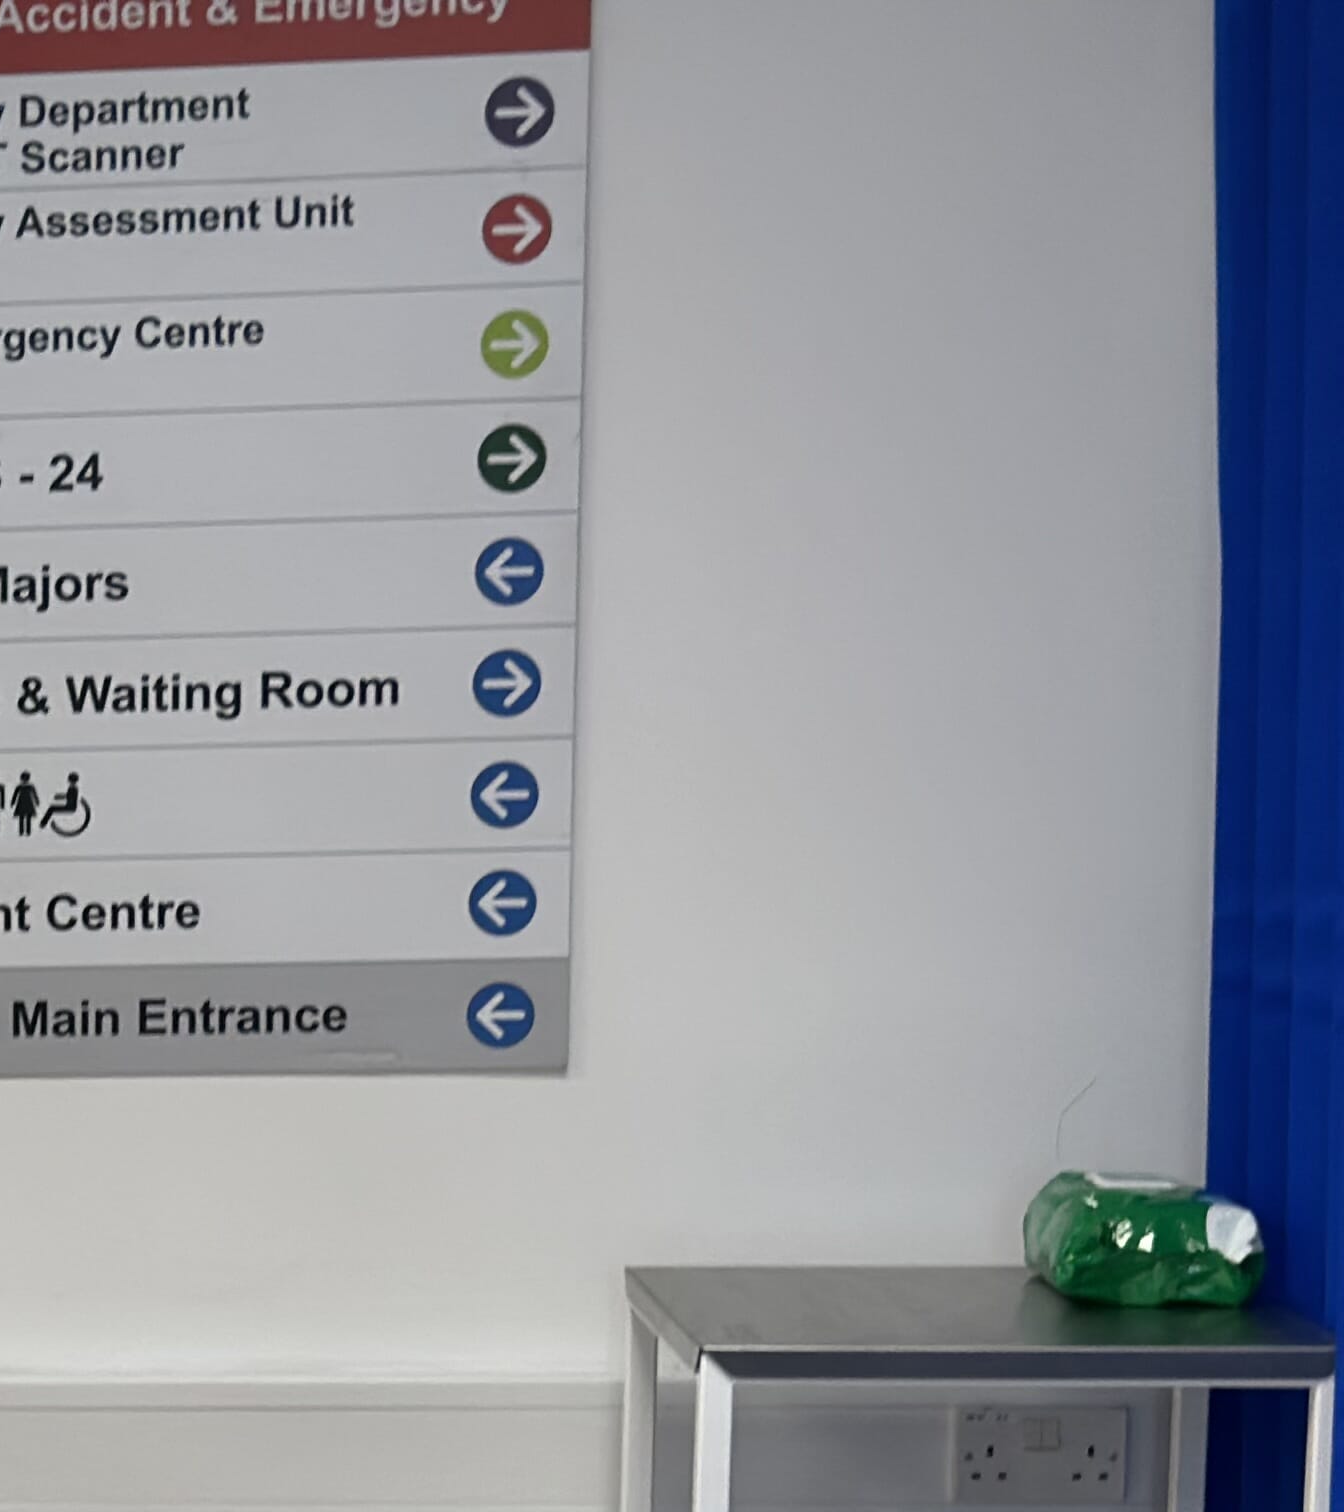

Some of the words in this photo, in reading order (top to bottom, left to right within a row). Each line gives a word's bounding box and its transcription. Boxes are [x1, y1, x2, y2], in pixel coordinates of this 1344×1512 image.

[205, 0, 238, 26] &
[20, 88, 249, 134] Department
[21, 141, 185, 174] Scanner
[16, 206, 260, 240] Assessment
[275, 194, 354, 229] Unit
[135, 316, 264, 348] Centre
[19, 474, 34, 483] -
[49, 453, 103, 492] 24
[17, 677, 49, 715] &
[65, 673, 243, 720] Waiting
[261, 671, 399, 709] Room
[46, 894, 200, 931] Centre
[12, 999, 120, 1038] Main
[138, 997, 348, 1036] Entrance
